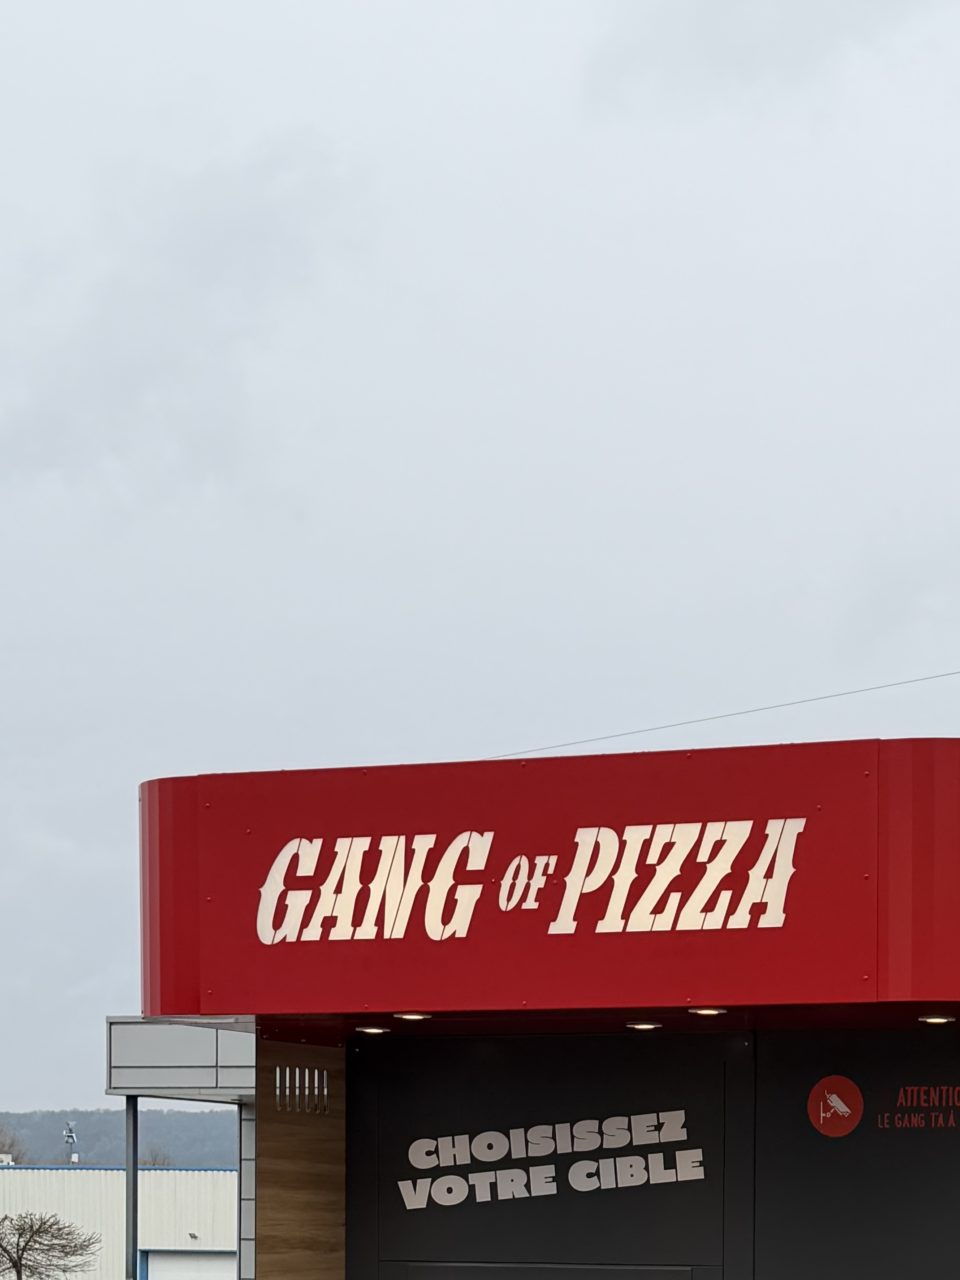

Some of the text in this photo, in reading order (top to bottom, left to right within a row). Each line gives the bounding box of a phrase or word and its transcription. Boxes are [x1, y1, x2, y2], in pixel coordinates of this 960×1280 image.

[256, 817, 808, 946] GANG OF PIZZA
[408, 1109, 688, 1170] CHOISISSEZ
[878, 1113, 891, 1128] LE
[895, 1112, 926, 1128] GANG
[398, 1148, 705, 1210] VOTRE CIBLE
